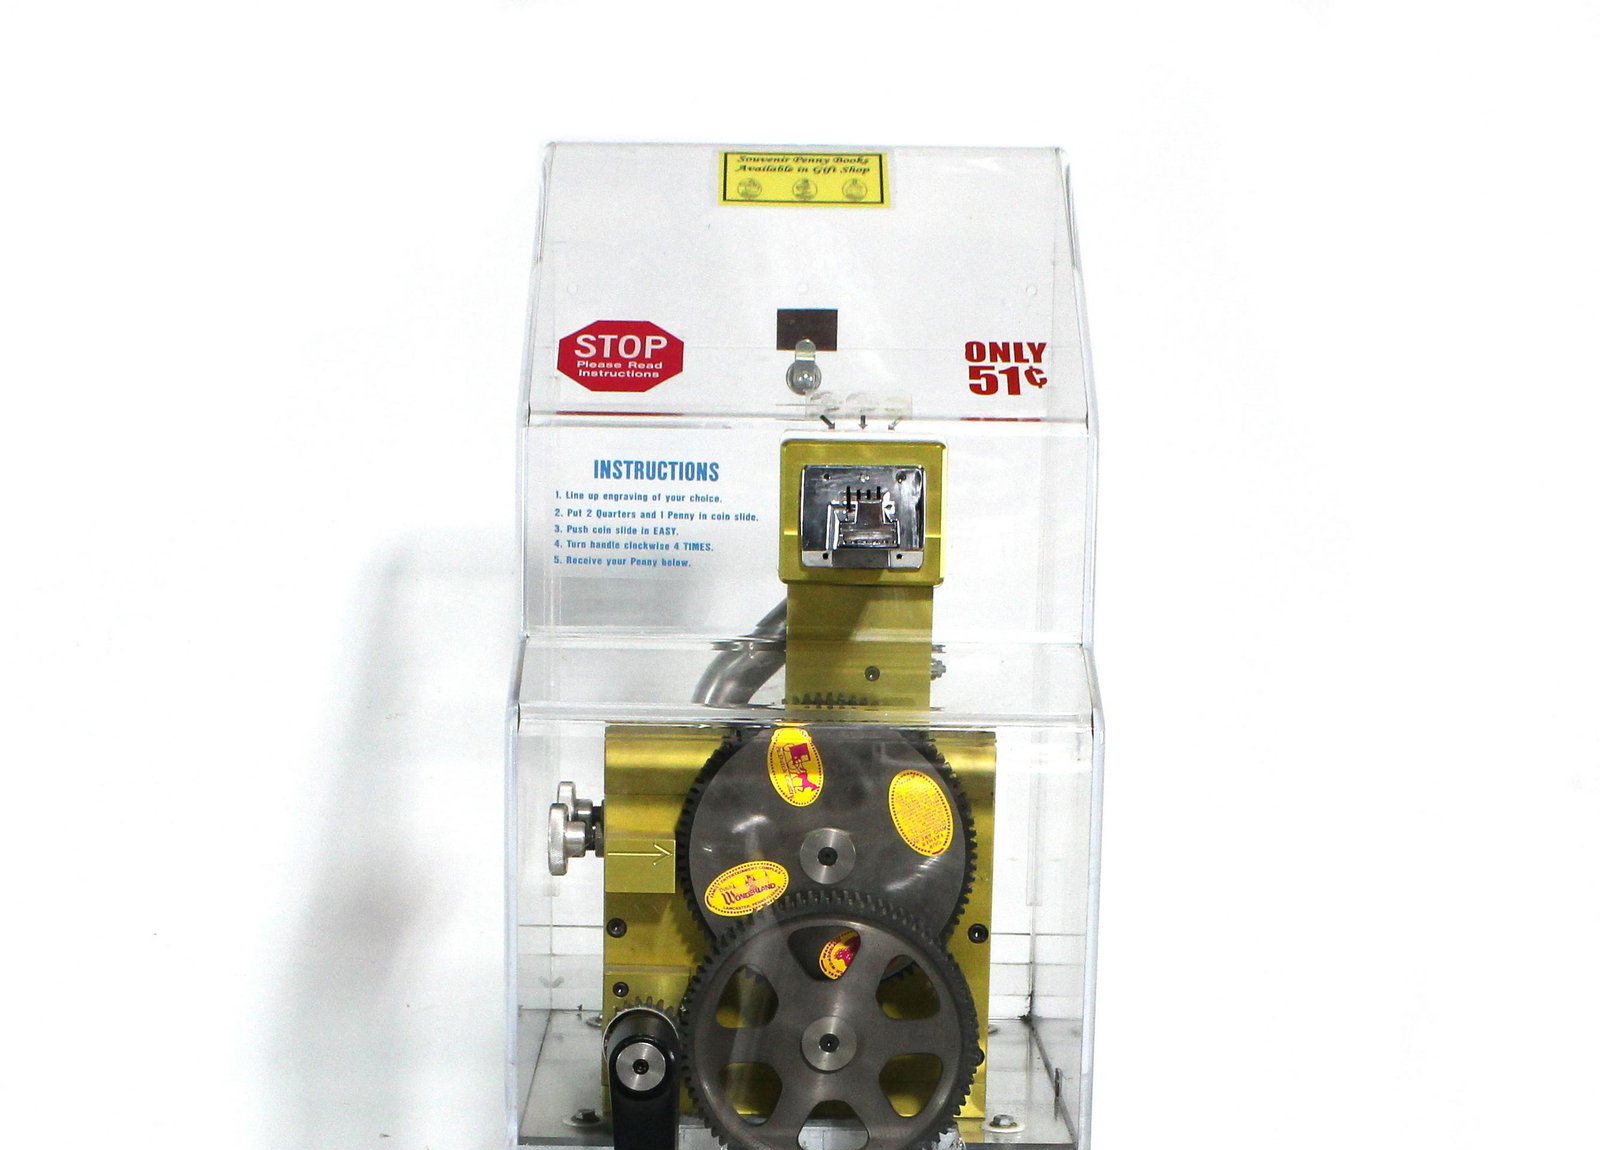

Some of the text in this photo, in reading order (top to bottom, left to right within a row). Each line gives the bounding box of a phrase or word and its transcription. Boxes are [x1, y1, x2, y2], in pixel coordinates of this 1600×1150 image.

[737, 155, 869, 165] Souvenir Penny Books
[735, 164, 793, 172] Available
[813, 165, 837, 175] Gift
[840, 166, 870, 174] Shop
[574, 334, 668, 359] STOP
[964, 340, 1047, 363] ONLY
[577, 360, 663, 370] Please Read
[578, 369, 660, 378] Instructions
[968, 365, 1048, 396] 51¢
[594, 459, 719, 481] INSTRUCTIONS
[555, 491, 722, 503] 1. Line up engraving of your choice.
[555, 508, 759, 521] 2. Put 2 Quarters and 1 Penny in coin slide.
[554, 524, 679, 536] 3. Push coin slide in EASY.
[554, 539, 713, 551] 4. Turn handle clockwise 4 TIMES.
[554, 555, 691, 567] 5. Receive your Penny below.
